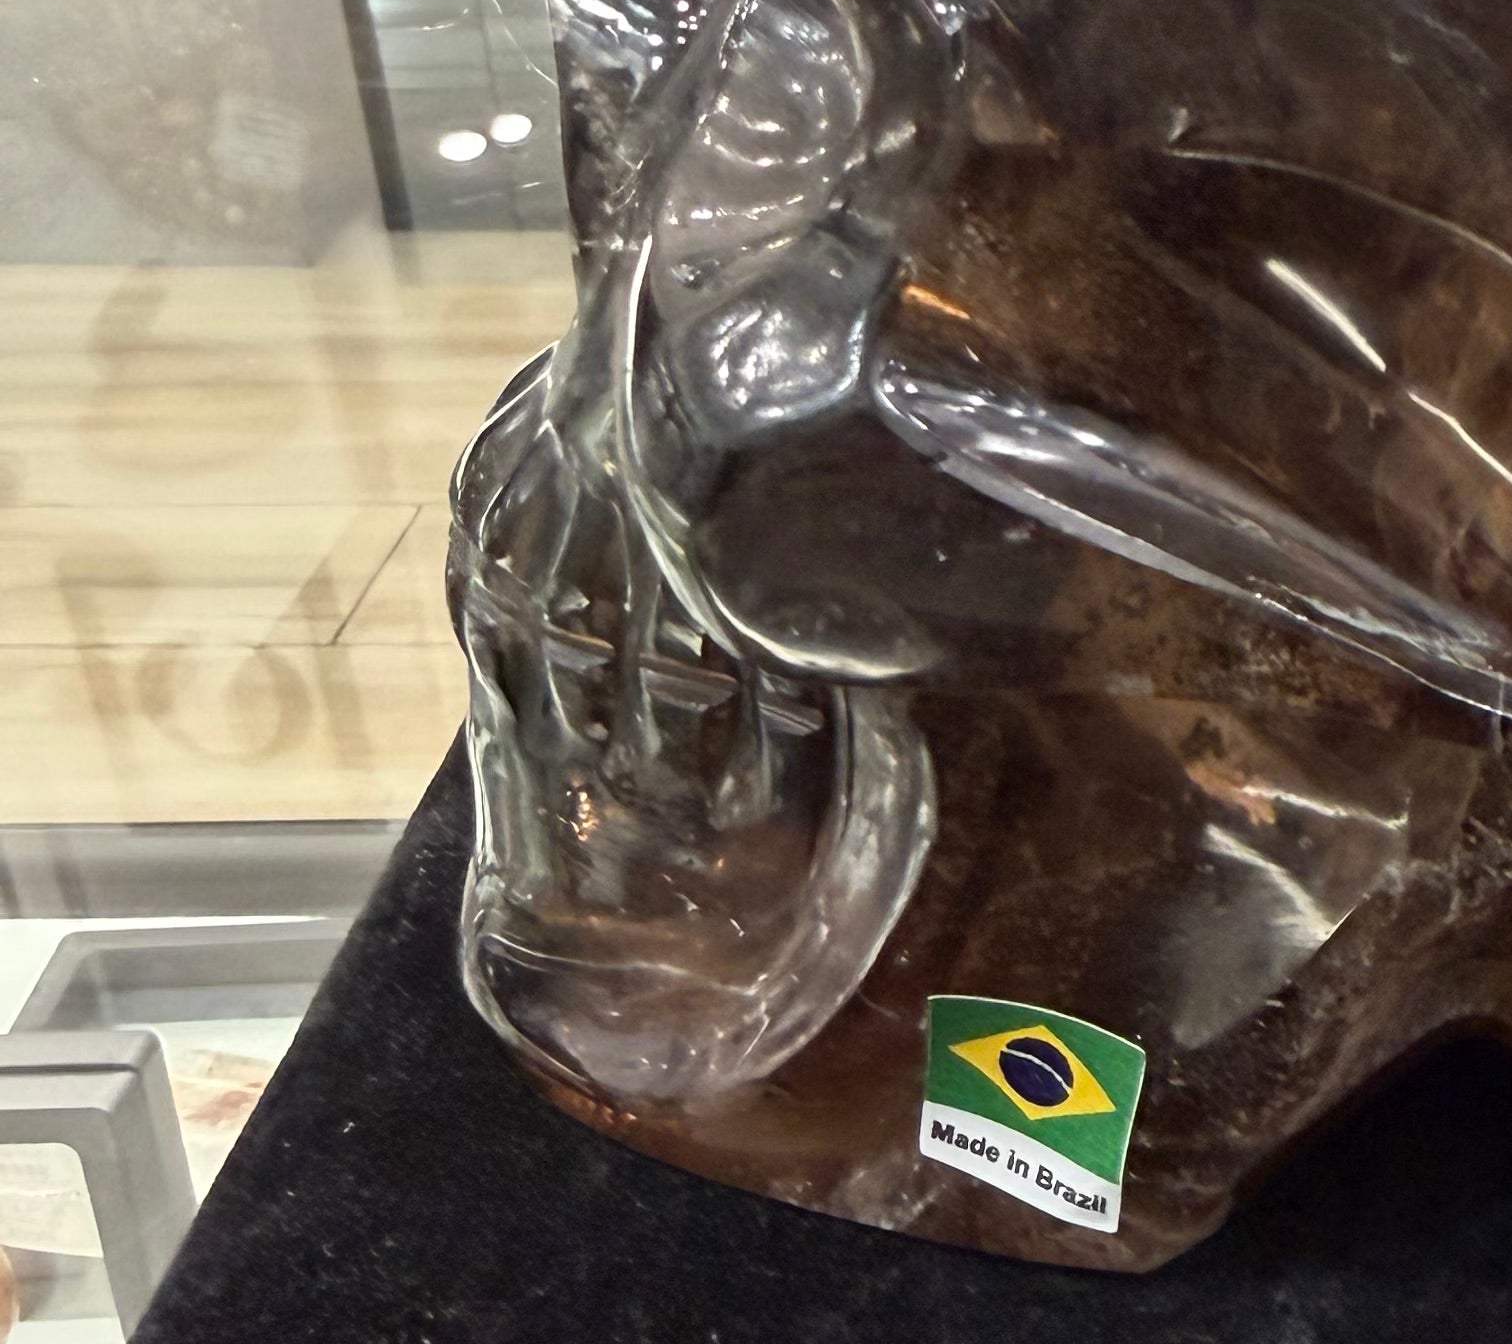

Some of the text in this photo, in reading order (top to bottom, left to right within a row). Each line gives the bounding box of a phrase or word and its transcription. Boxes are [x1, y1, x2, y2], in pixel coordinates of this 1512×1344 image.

[930, 1119, 1108, 1215] Made in Brazil
